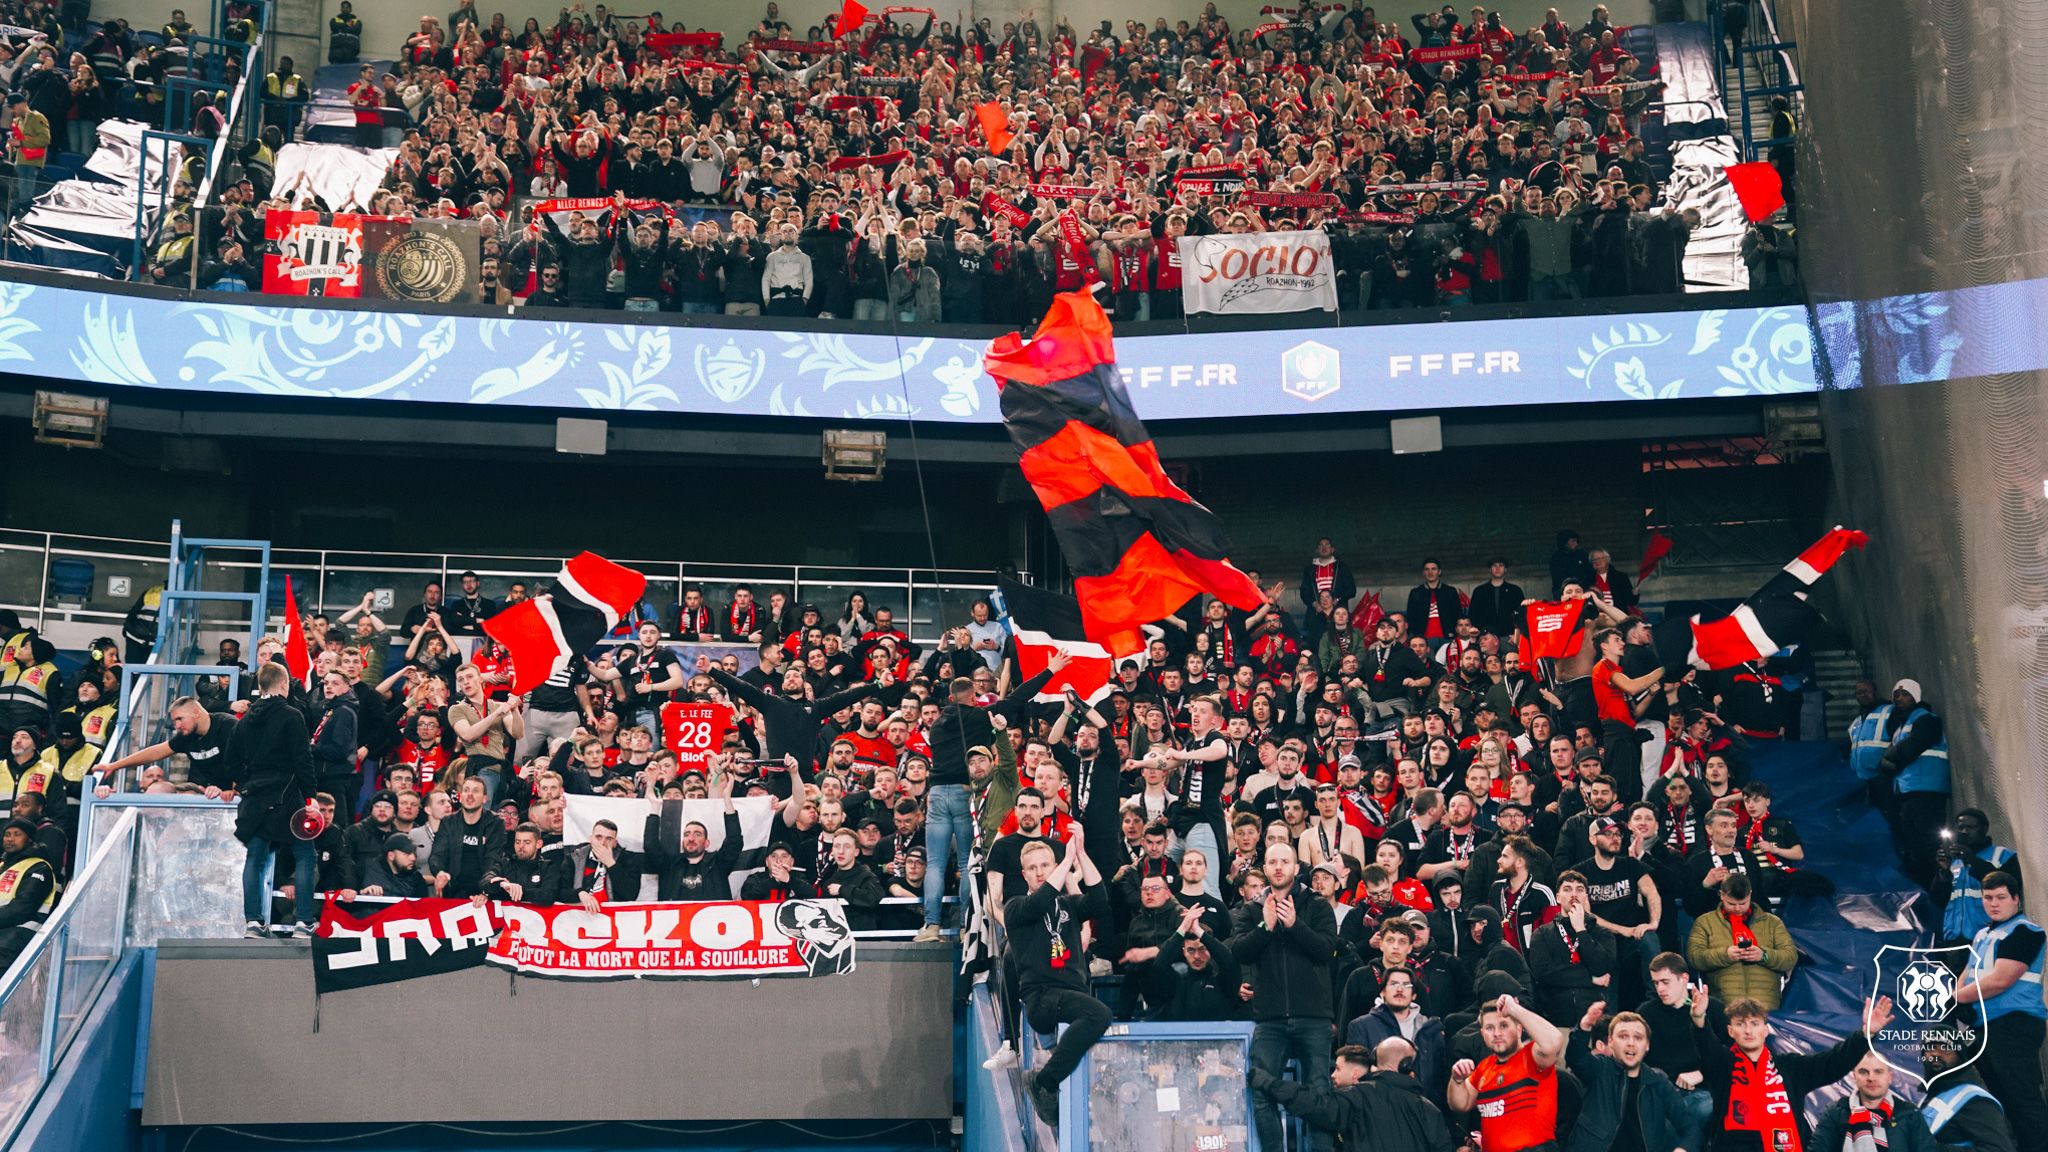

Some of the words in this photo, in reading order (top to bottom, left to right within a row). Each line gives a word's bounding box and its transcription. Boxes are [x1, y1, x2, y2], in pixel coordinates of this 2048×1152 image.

[556, 199, 578, 210] ALLEZ
[578, 198, 604, 208] RENNES
[437, 248, 453, 271] CALL
[689, 709, 698, 718] LE
[677, 721, 712, 749] 28
[681, 752, 705, 763] Blot
[1588, 879, 1630, 895] TRIBUNE
[559, 951, 580, 967] LA
[586, 951, 635, 968] MORT
[638, 950, 670, 968] QUE
[675, 950, 696, 967] LA
[701, 949, 789, 967] SOUILLURE
